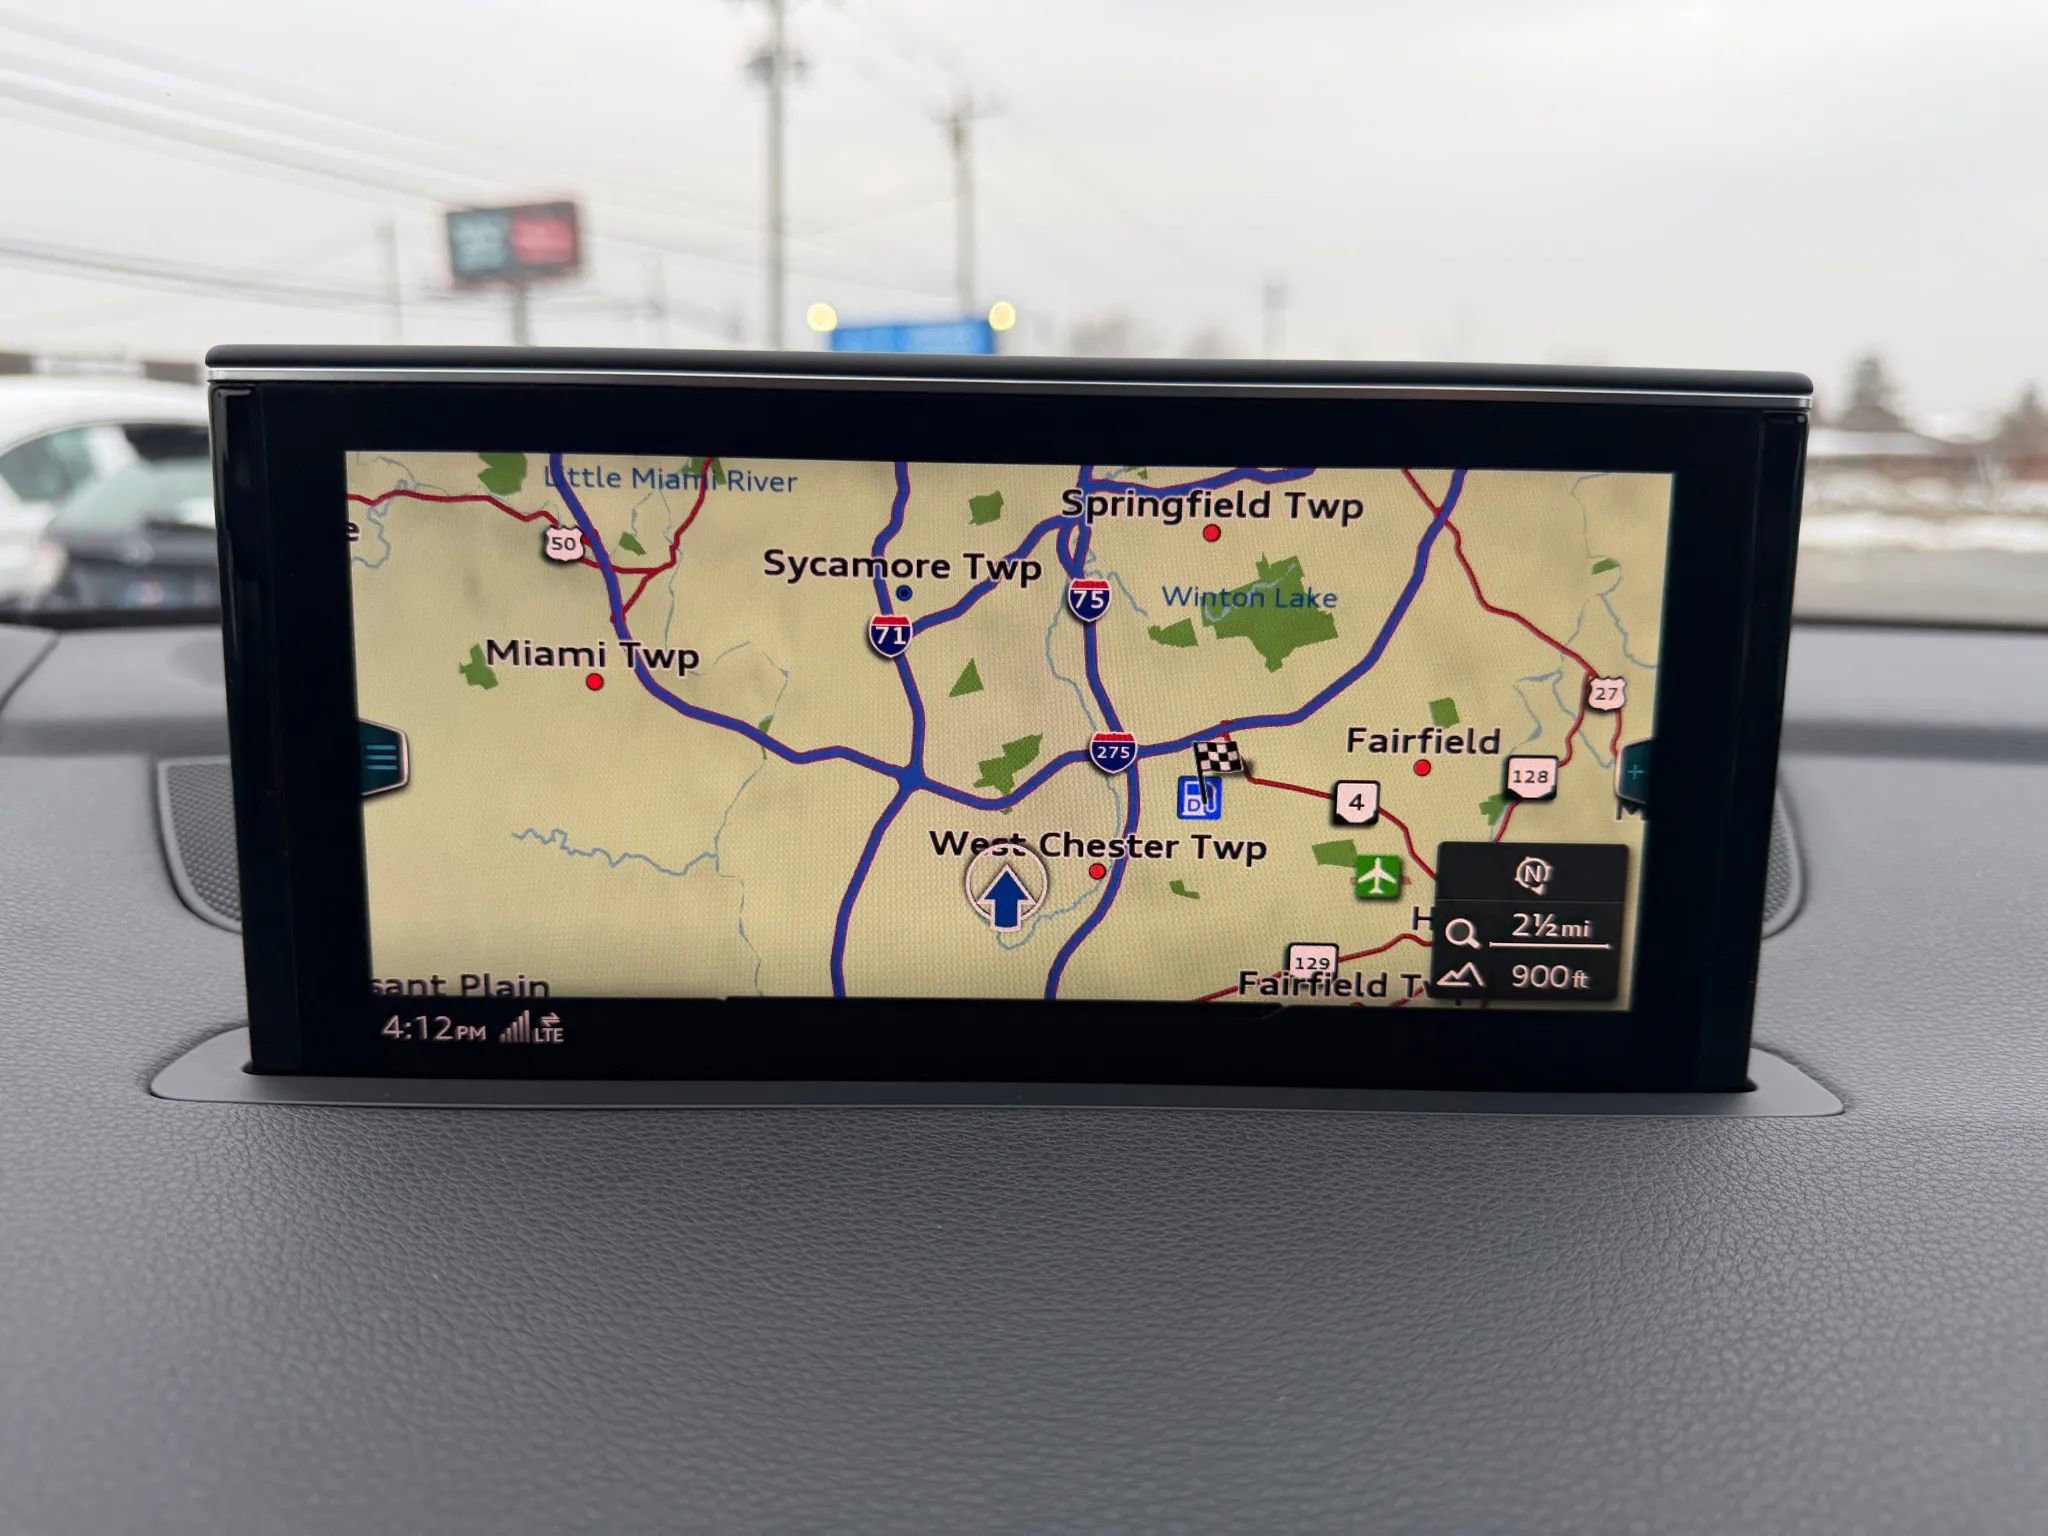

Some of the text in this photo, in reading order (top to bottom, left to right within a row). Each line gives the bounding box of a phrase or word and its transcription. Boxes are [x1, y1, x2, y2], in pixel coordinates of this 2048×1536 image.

[544, 465, 798, 492] Lttle Miami River
[1061, 489, 1364, 527] Springfield Twp
[552, 536, 577, 551] 50
[764, 549, 1042, 587] Sycamore Twp
[1073, 590, 1103, 609] 75
[1162, 585, 1338, 609] Winton Lake
[875, 627, 906, 644] 71
[487, 639, 699, 675] Miami Twp
[1595, 688, 1618, 700] 27
[1347, 727, 1500, 755] Fairfield
[1097, 746, 1130, 759] 275
[1513, 770, 1548, 784] 128
[1348, 793, 1365, 811] 4
[929, 830, 1267, 867] West Chester Twp
[1295, 956, 1330, 971] 129
[460, 973, 549, 997] Plain
[1238, 971, 1387, 998] Fairfield
[535, 1028, 564, 1042] LTE
